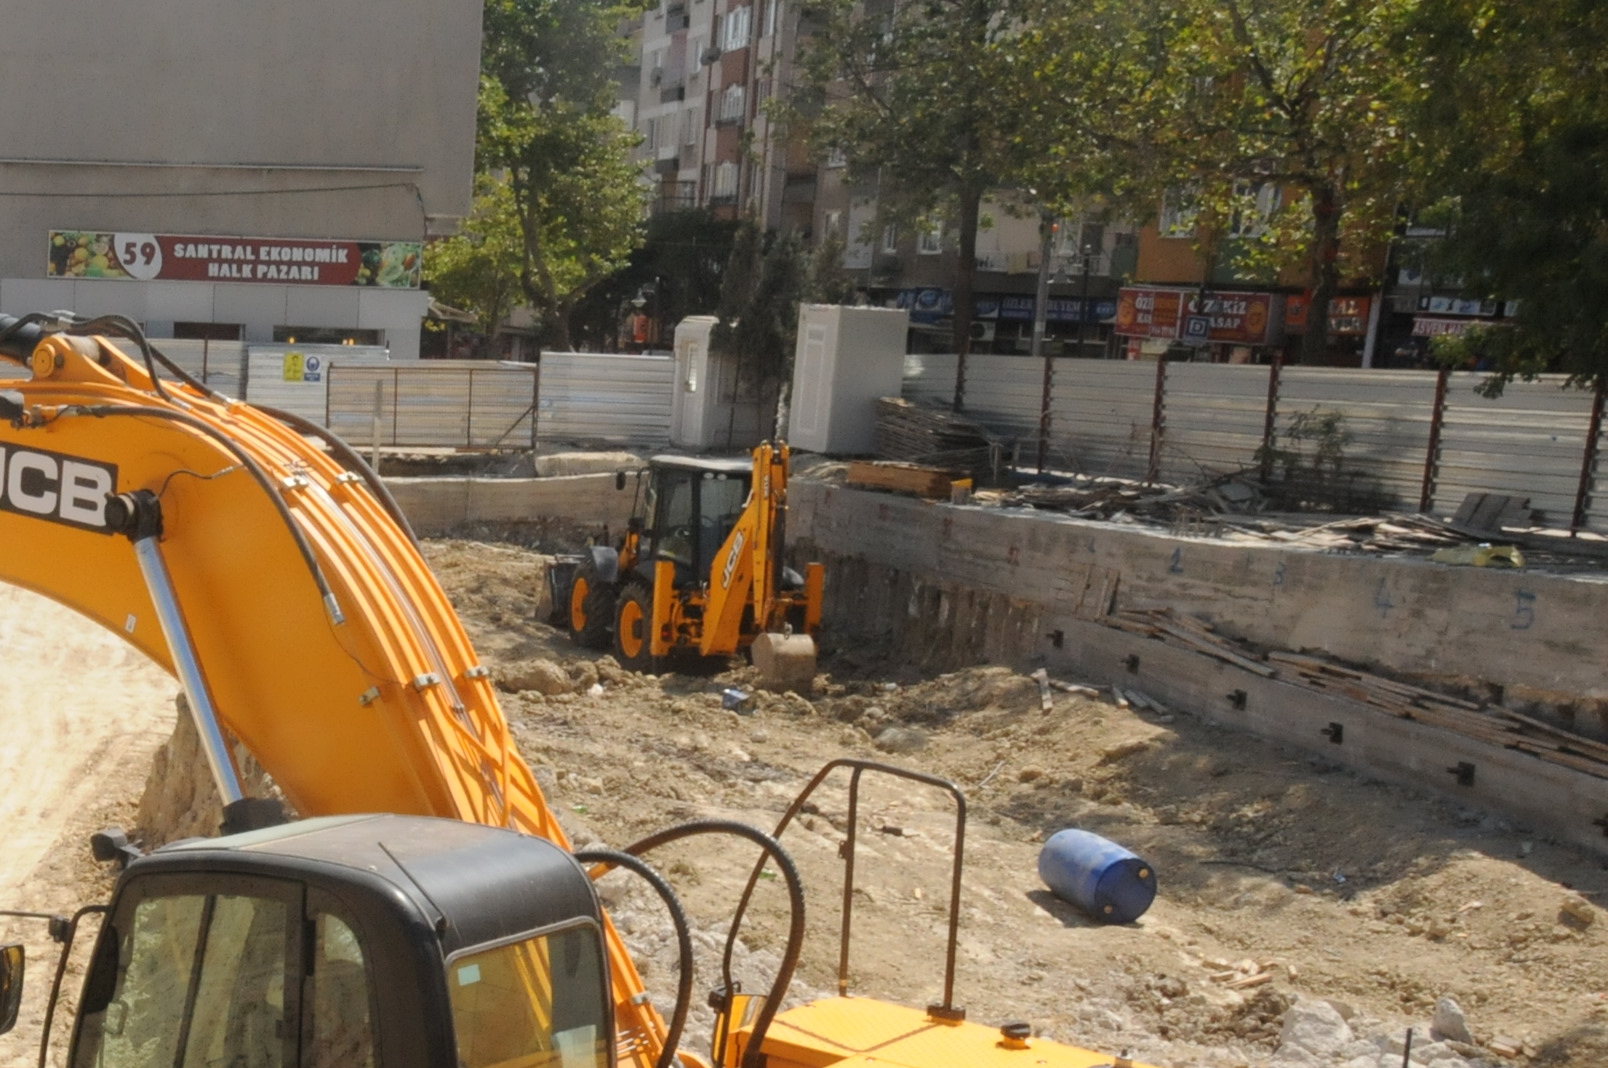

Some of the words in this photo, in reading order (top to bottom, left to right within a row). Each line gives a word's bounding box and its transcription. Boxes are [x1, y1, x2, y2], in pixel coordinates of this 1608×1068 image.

[122, 242, 158, 266] 59
[173, 243, 256, 261] SANTRAL
[259, 244, 348, 264] EKONOMİK
[207, 263, 253, 279] HALK
[256, 264, 319, 281] PAZARI
[722, 531, 744, 589] JCB
